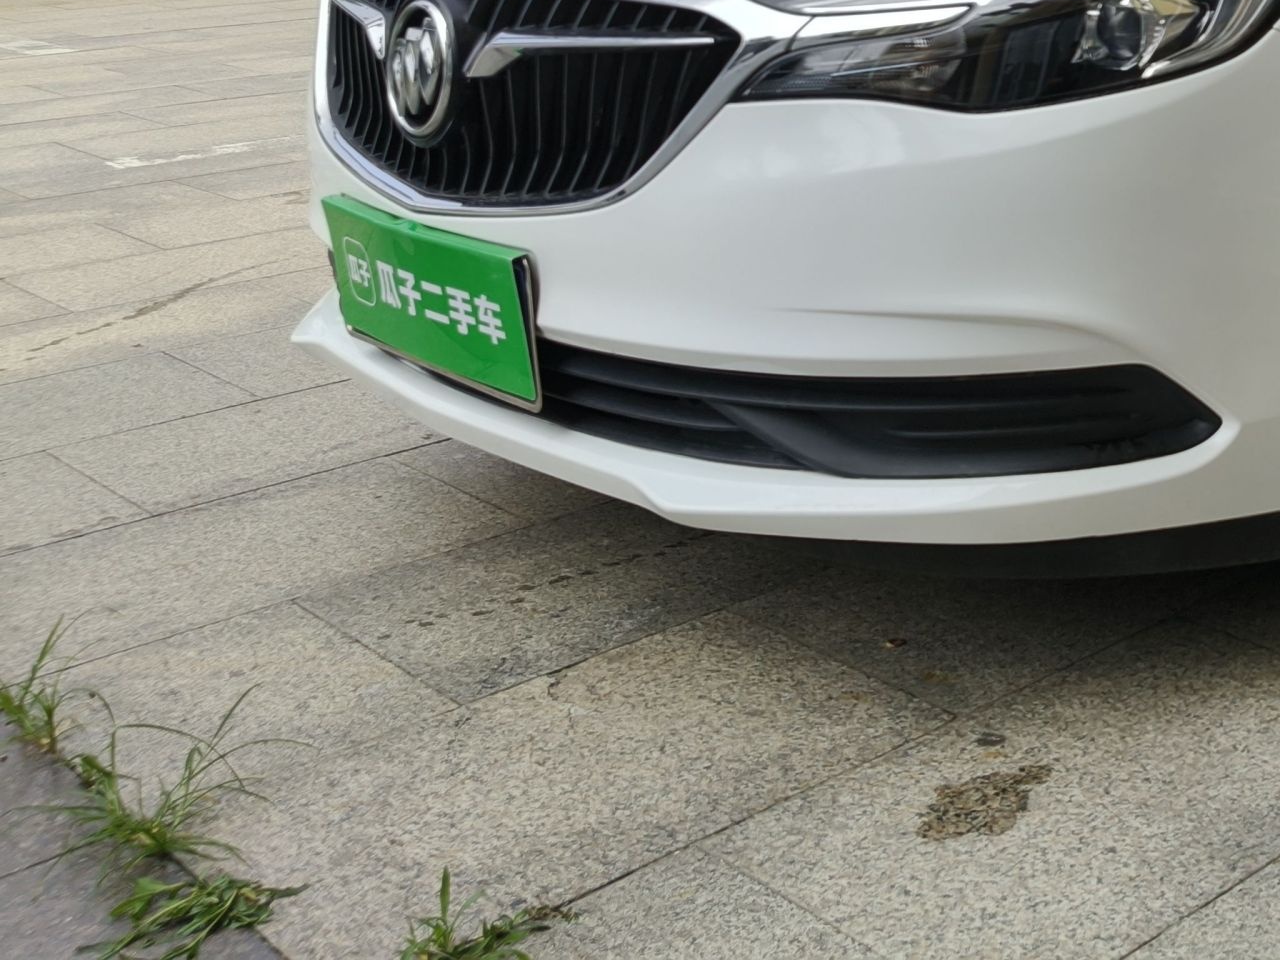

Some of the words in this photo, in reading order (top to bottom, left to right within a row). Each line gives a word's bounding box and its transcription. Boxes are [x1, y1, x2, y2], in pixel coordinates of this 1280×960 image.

[376, 259, 507, 345] 瓜子二手车
